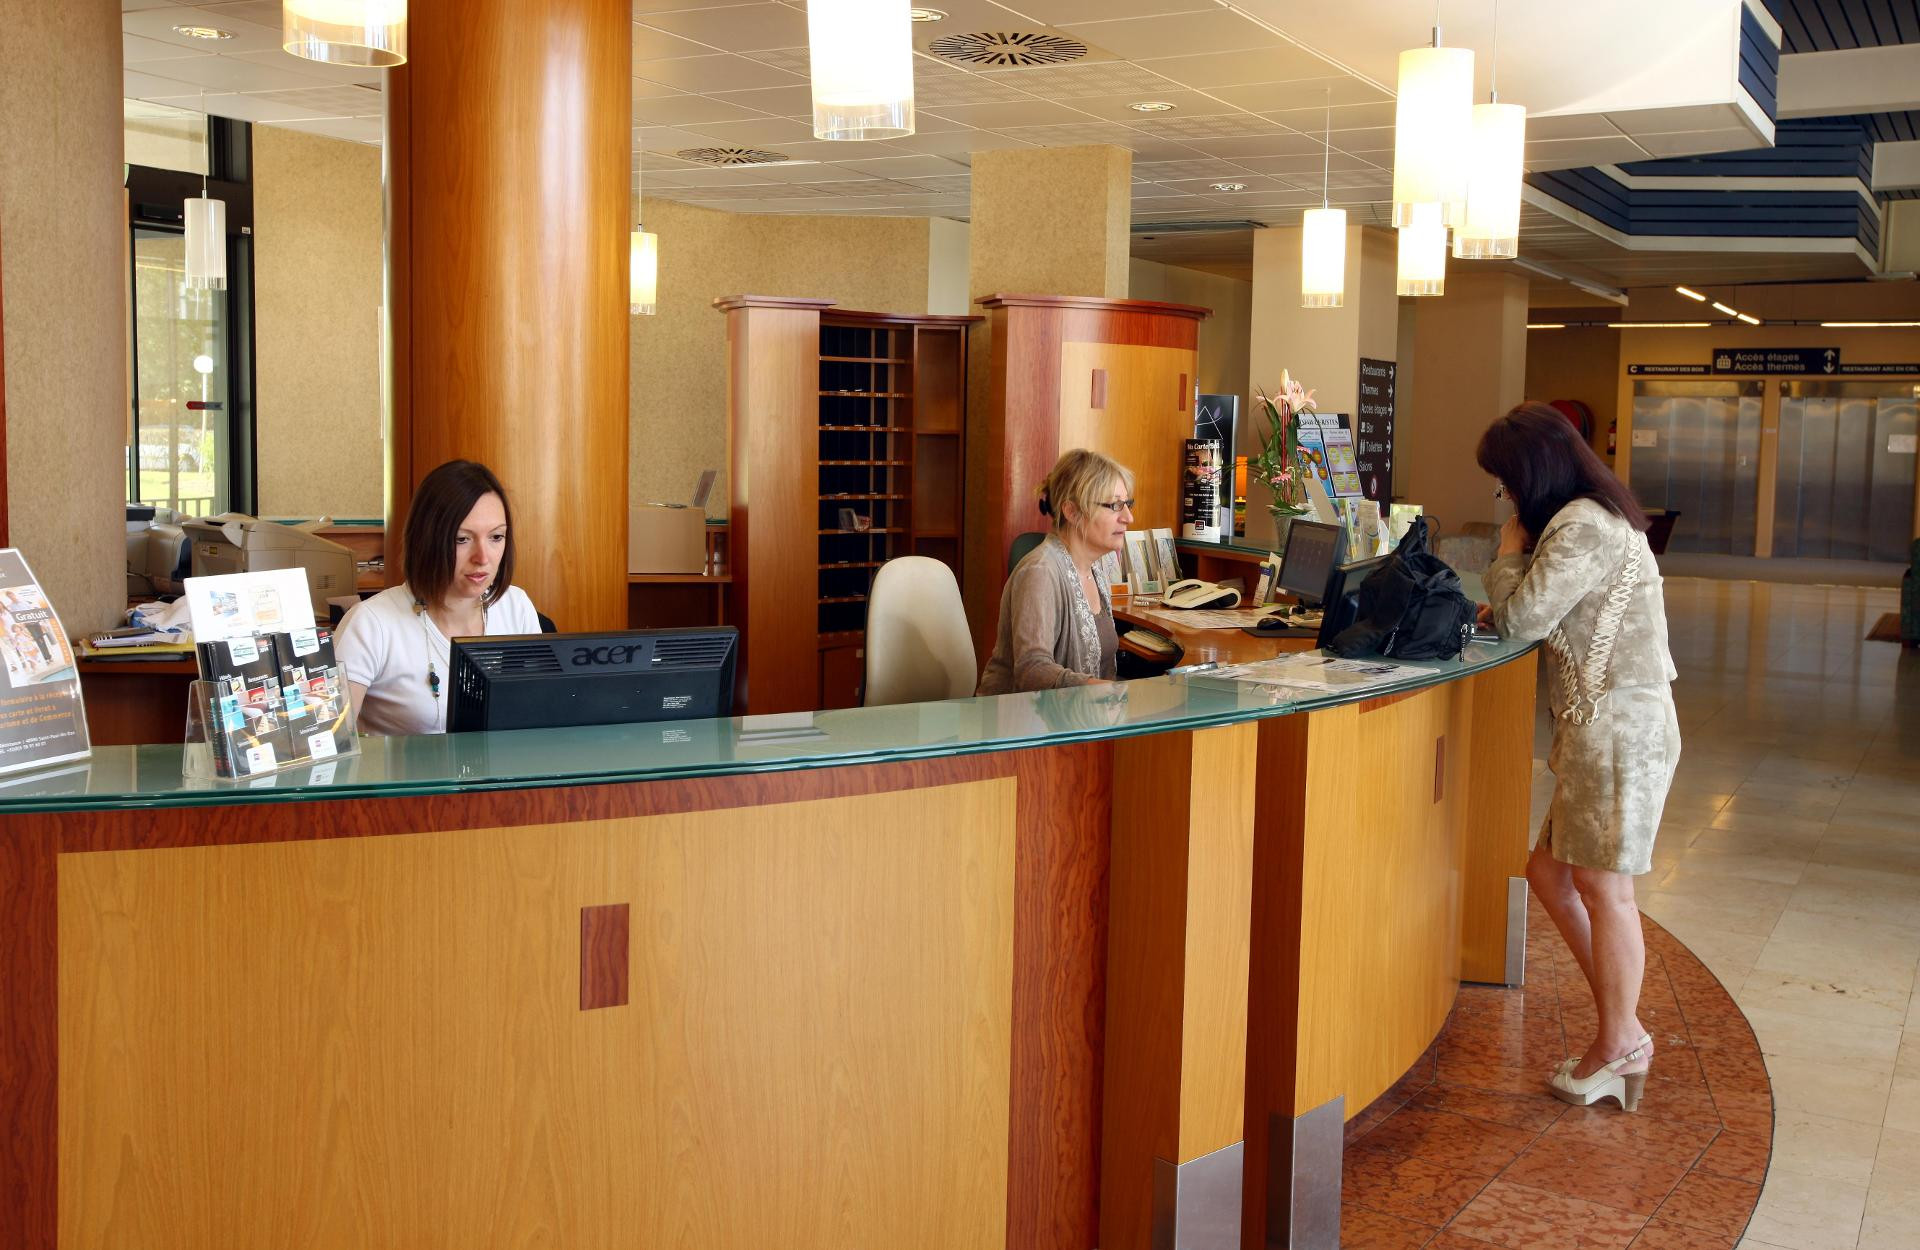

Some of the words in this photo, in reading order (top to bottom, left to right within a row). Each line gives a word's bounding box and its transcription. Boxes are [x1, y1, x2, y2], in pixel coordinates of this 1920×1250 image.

[1735, 353, 1764, 361] Accès
[1767, 353, 1799, 363] étages
[1735, 363, 1764, 371] Accès
[1767, 362, 1805, 371] thermes
[15, 609, 48, 621] Gratuit
[571, 644, 642, 666] acer
